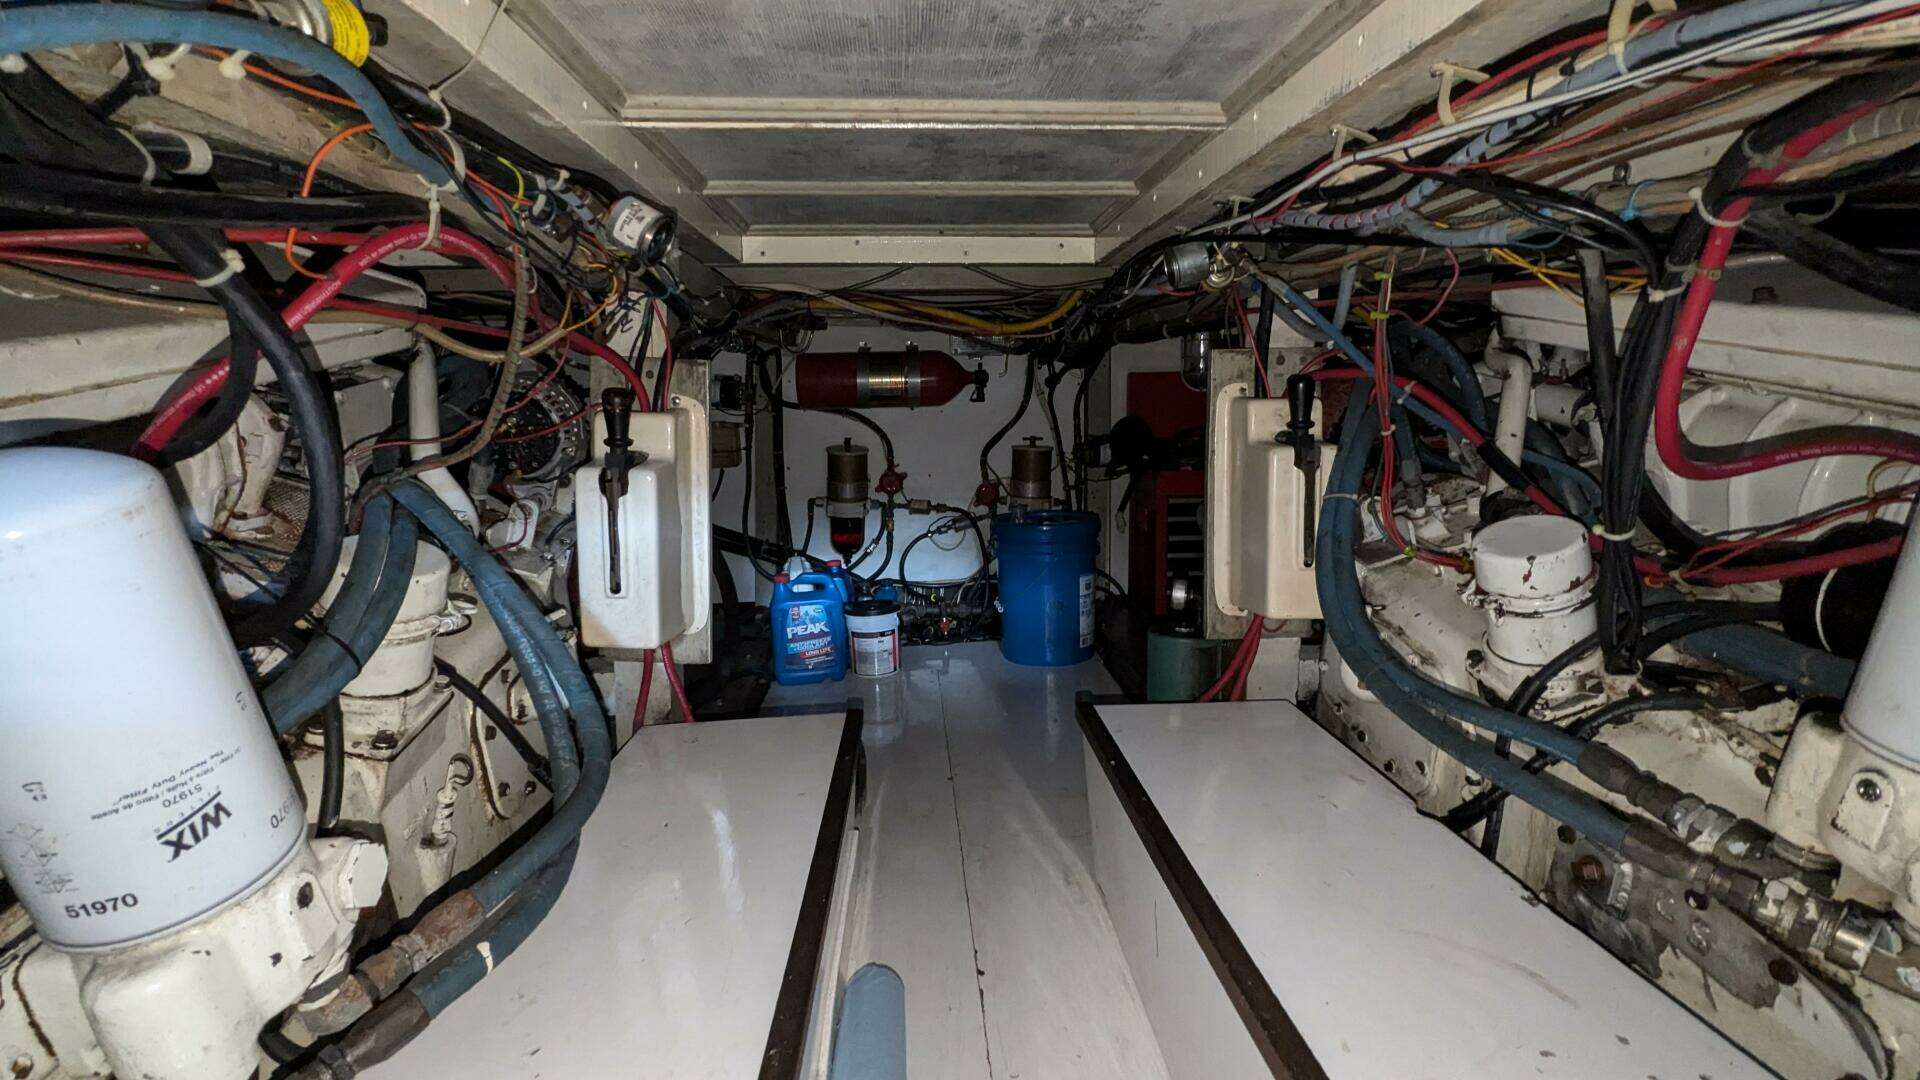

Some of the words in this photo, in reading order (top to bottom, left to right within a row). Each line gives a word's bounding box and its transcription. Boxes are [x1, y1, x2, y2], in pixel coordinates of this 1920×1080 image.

[787, 623, 831, 640] PEAK
[179, 759, 207, 777] Heavy
[151, 775, 176, 790] Duty
[162, 783, 203, 809] 51970
[160, 801, 233, 862] WIX
[65, 892, 139, 920] 51970
